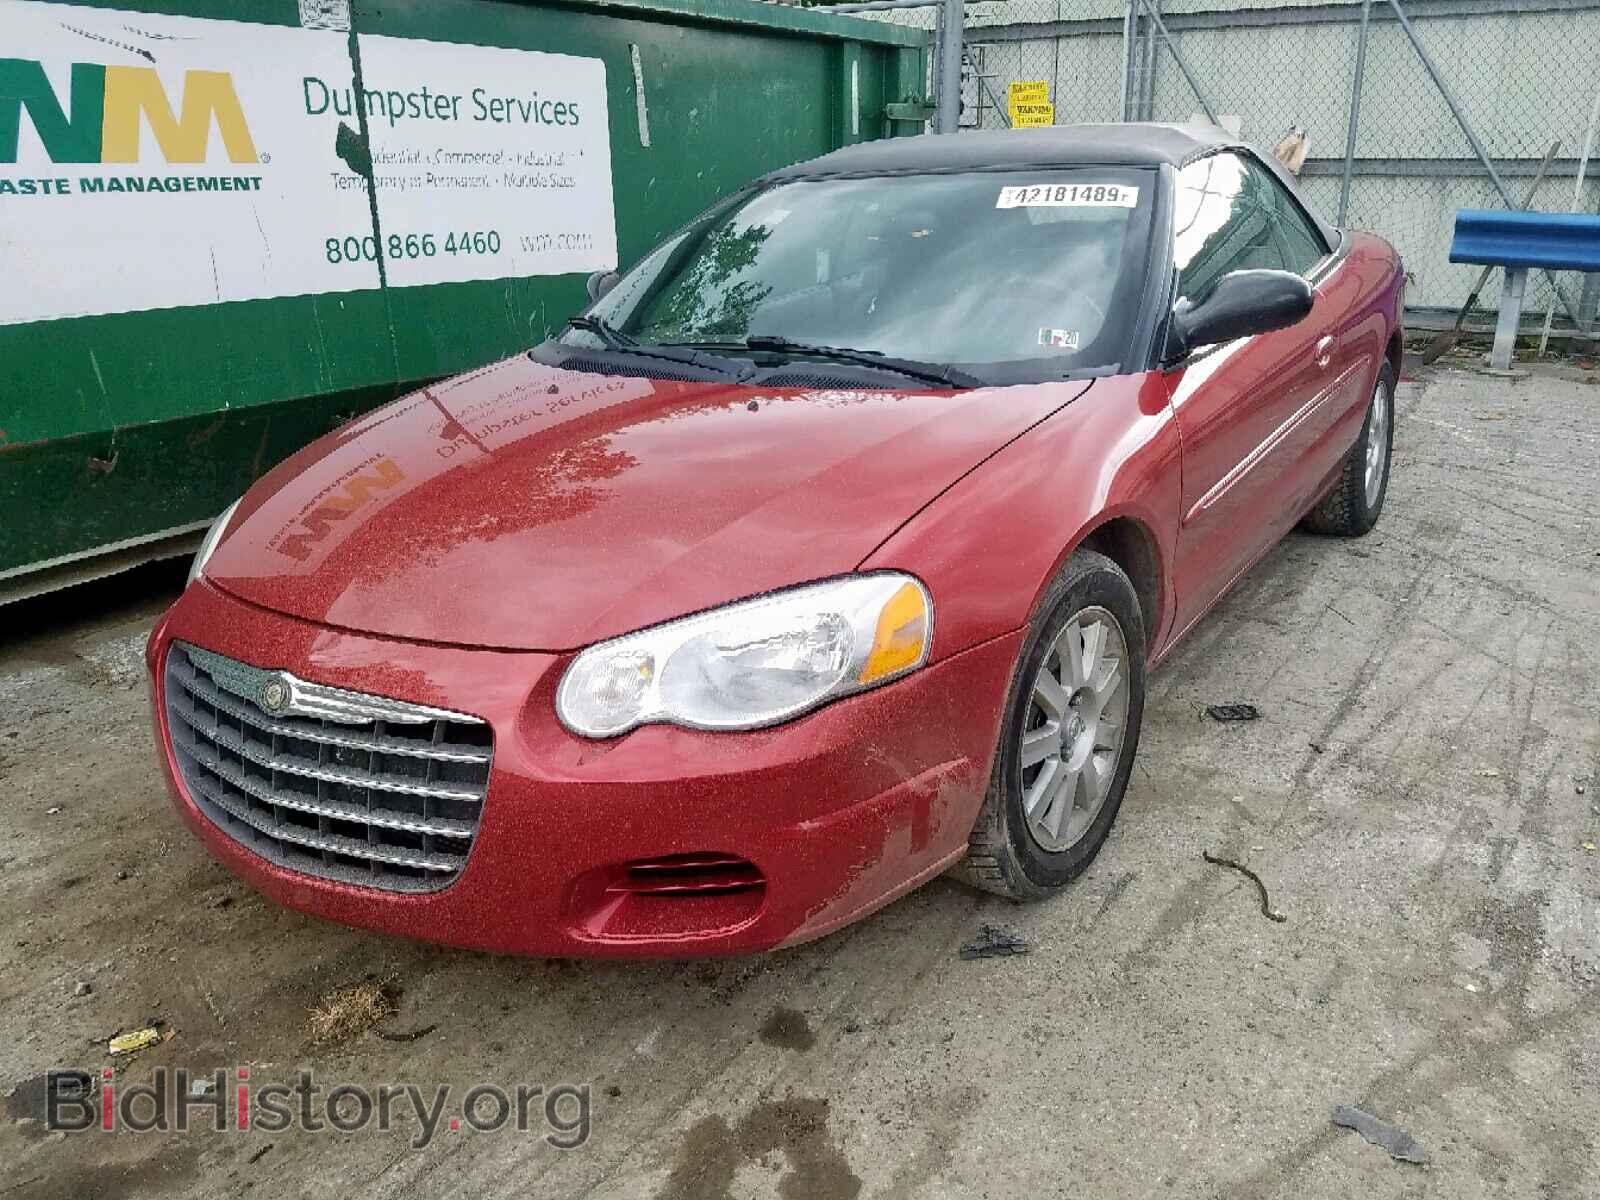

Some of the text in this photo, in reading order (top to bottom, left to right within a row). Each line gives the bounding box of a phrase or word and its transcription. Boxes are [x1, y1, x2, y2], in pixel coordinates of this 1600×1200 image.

[302, 76, 579, 127] Dumpster Services
[0, 176, 263, 195] ASTE MANAGEMENT
[1015, 185, 1120, 203] 42181489
[325, 234, 377, 263] 800
[388, 233, 437, 259] 866
[444, 230, 501, 256] 4460
